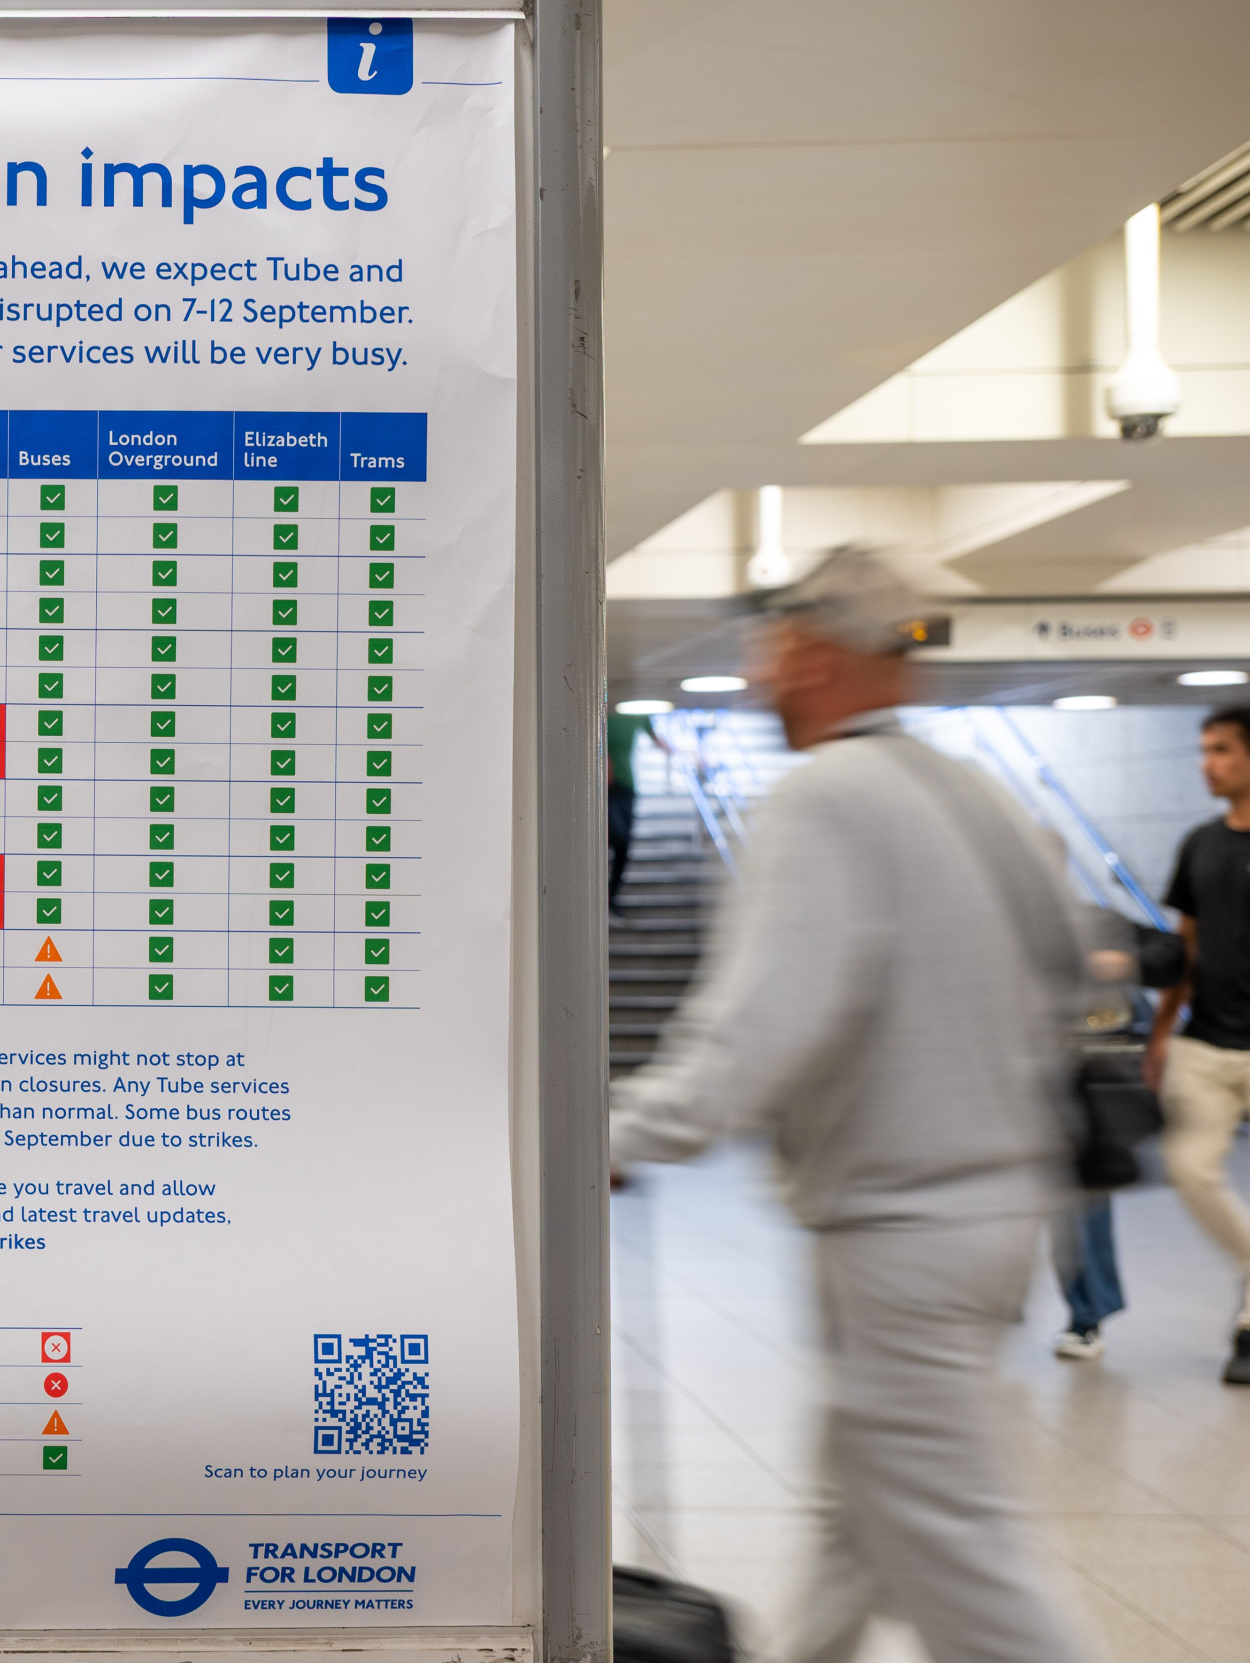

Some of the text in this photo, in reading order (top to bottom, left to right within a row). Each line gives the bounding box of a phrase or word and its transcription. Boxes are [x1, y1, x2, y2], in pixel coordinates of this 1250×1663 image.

[82, 147, 388, 224] impacts
[102, 262, 145, 280] we
[156, 260, 257, 286] expect
[267, 257, 338, 281] Tube
[350, 259, 402, 282] and
[134, 304, 171, 321] on
[182, 298, 232, 322] 7-12
[244, 298, 412, 328] September.
[13, 341, 134, 364] services
[145, 340, 200, 364] will
[211, 340, 245, 364] be
[256, 347, 321, 371] very
[332, 341, 406, 372] busy.
[109, 430, 177, 446] London
[245, 431, 328, 447] Elizabeth
[19, 451, 70, 466] Buses
[109, 451, 218, 470] Overground
[244, 452, 277, 467] line
[350, 453, 405, 468] Trams
[74, 1050, 130, 1070] might
[137, 1052, 170, 1066] not
[177, 1053, 219, 1070] stop
[226, 1053, 244, 1067] at
[4, 1130, 112, 1149] September
[119, 1131, 155, 1147] due
[162, 1133, 182, 1147] to
[189, 1132, 257, 1147] strikes.
[14, 1183, 49, 1199] you
[55, 1180, 113, 1195] travel
[119, 1180, 154, 1196] and
[162, 1180, 216, 1196] allow
[205, 1465, 427, 1481] Scan to plan your journey
[249, 1542, 403, 1559] TRANSPORT
[246, 1566, 416, 1583] FOR LONDON
[244, 1599, 413, 1610] EVERY JOURNEY MATTERS
